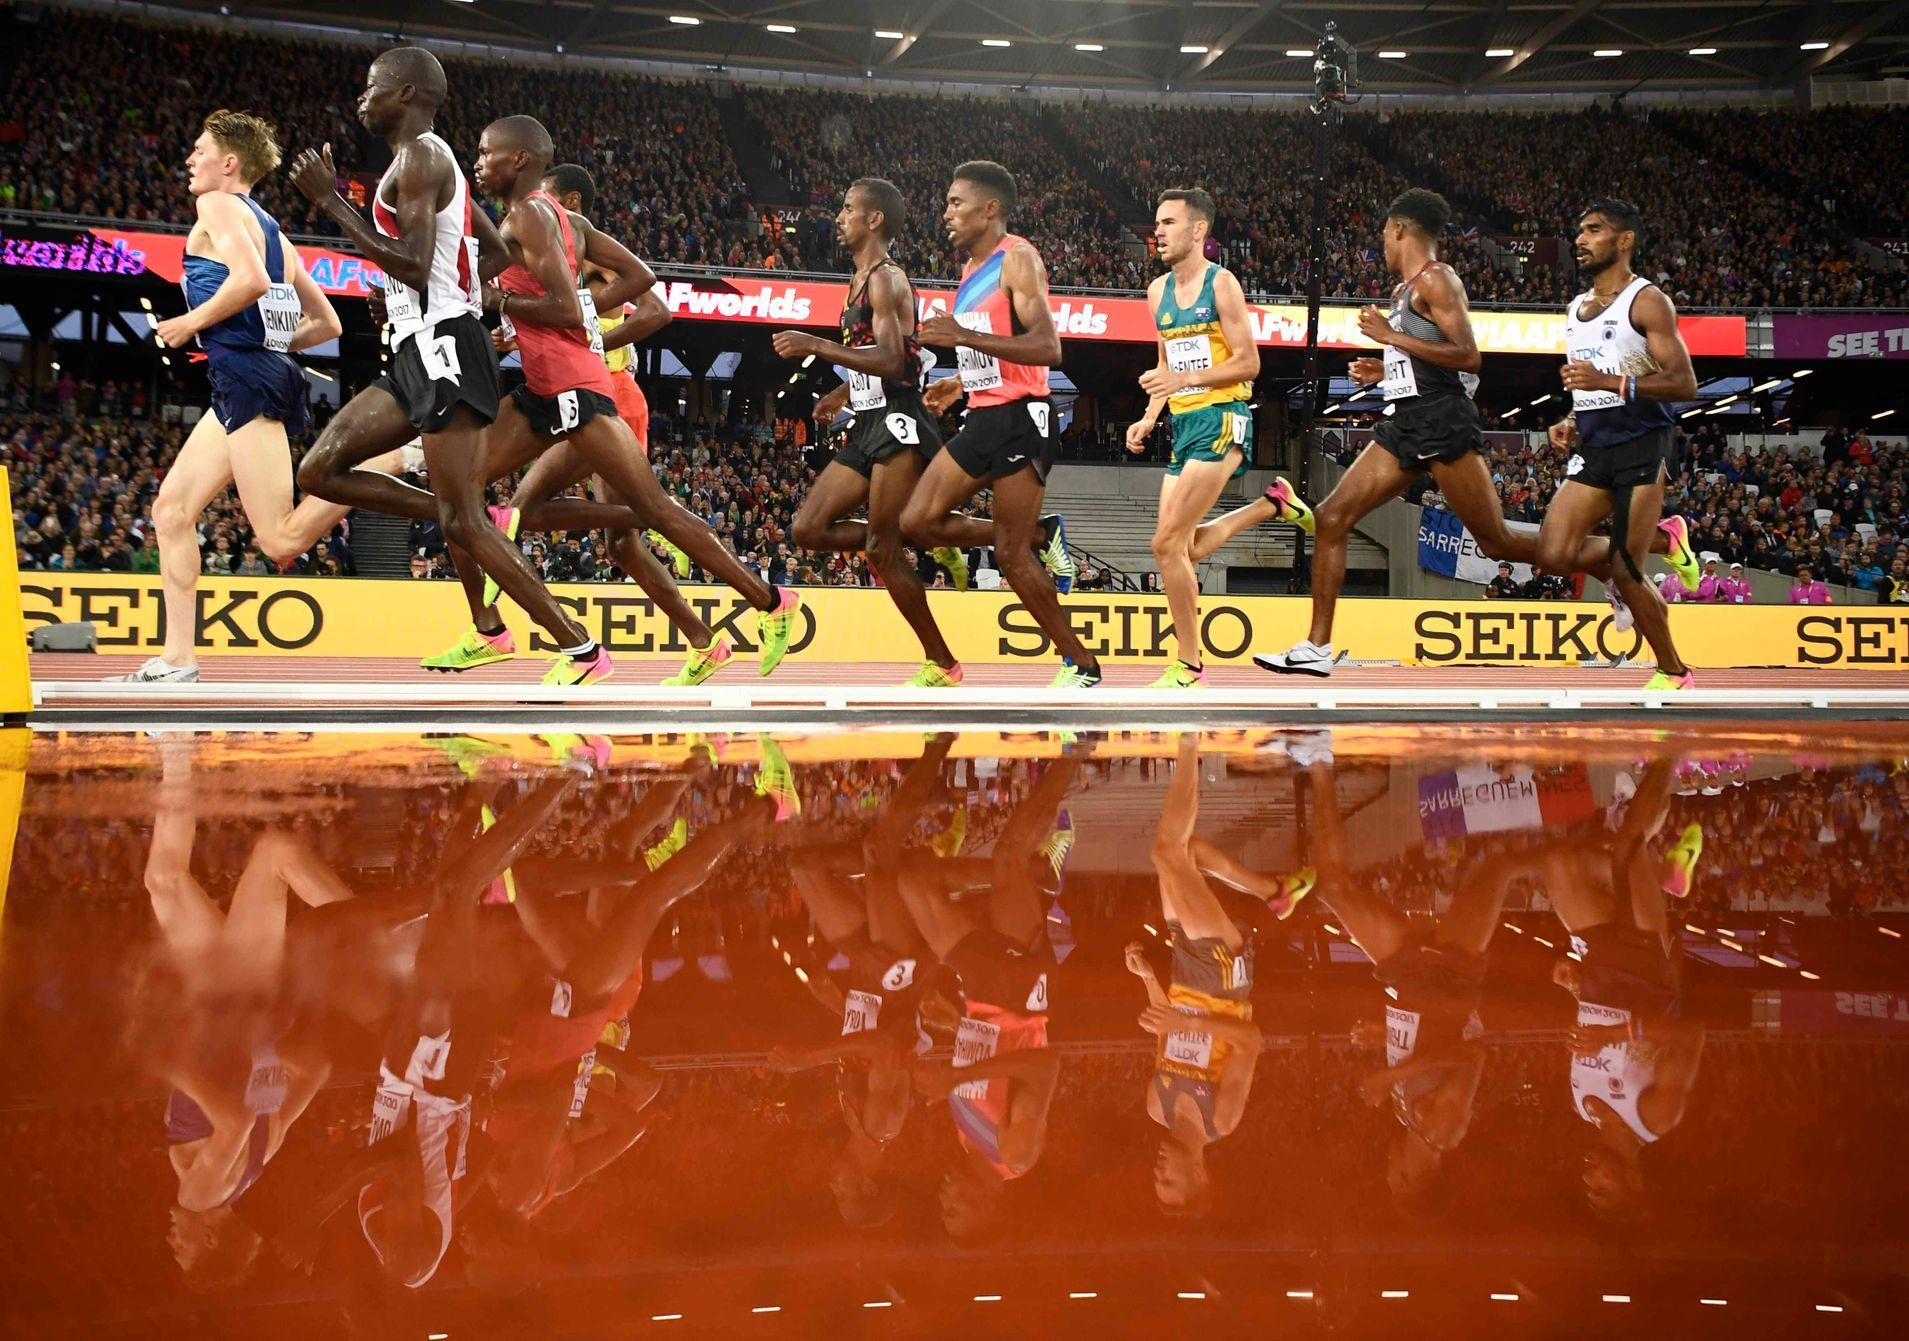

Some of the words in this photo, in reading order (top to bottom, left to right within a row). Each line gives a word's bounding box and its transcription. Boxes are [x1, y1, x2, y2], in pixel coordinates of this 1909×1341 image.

[1510, 241, 1535, 254] 242
[269, 287, 296, 301] TDK
[1175, 339, 1201, 352] TDK
[1828, 330, 1880, 358] SEE
[1576, 346, 1605, 361] TDK
[978, 376, 999, 388] 2017
[865, 396, 883, 408] 2017
[1599, 394, 1621, 406] 2017
[895, 417, 909, 440] 3
[20, 585, 324, 650] SEIKO
[998, 603, 1253, 659] SEIKO
[1414, 610, 1643, 662] SEIKO
